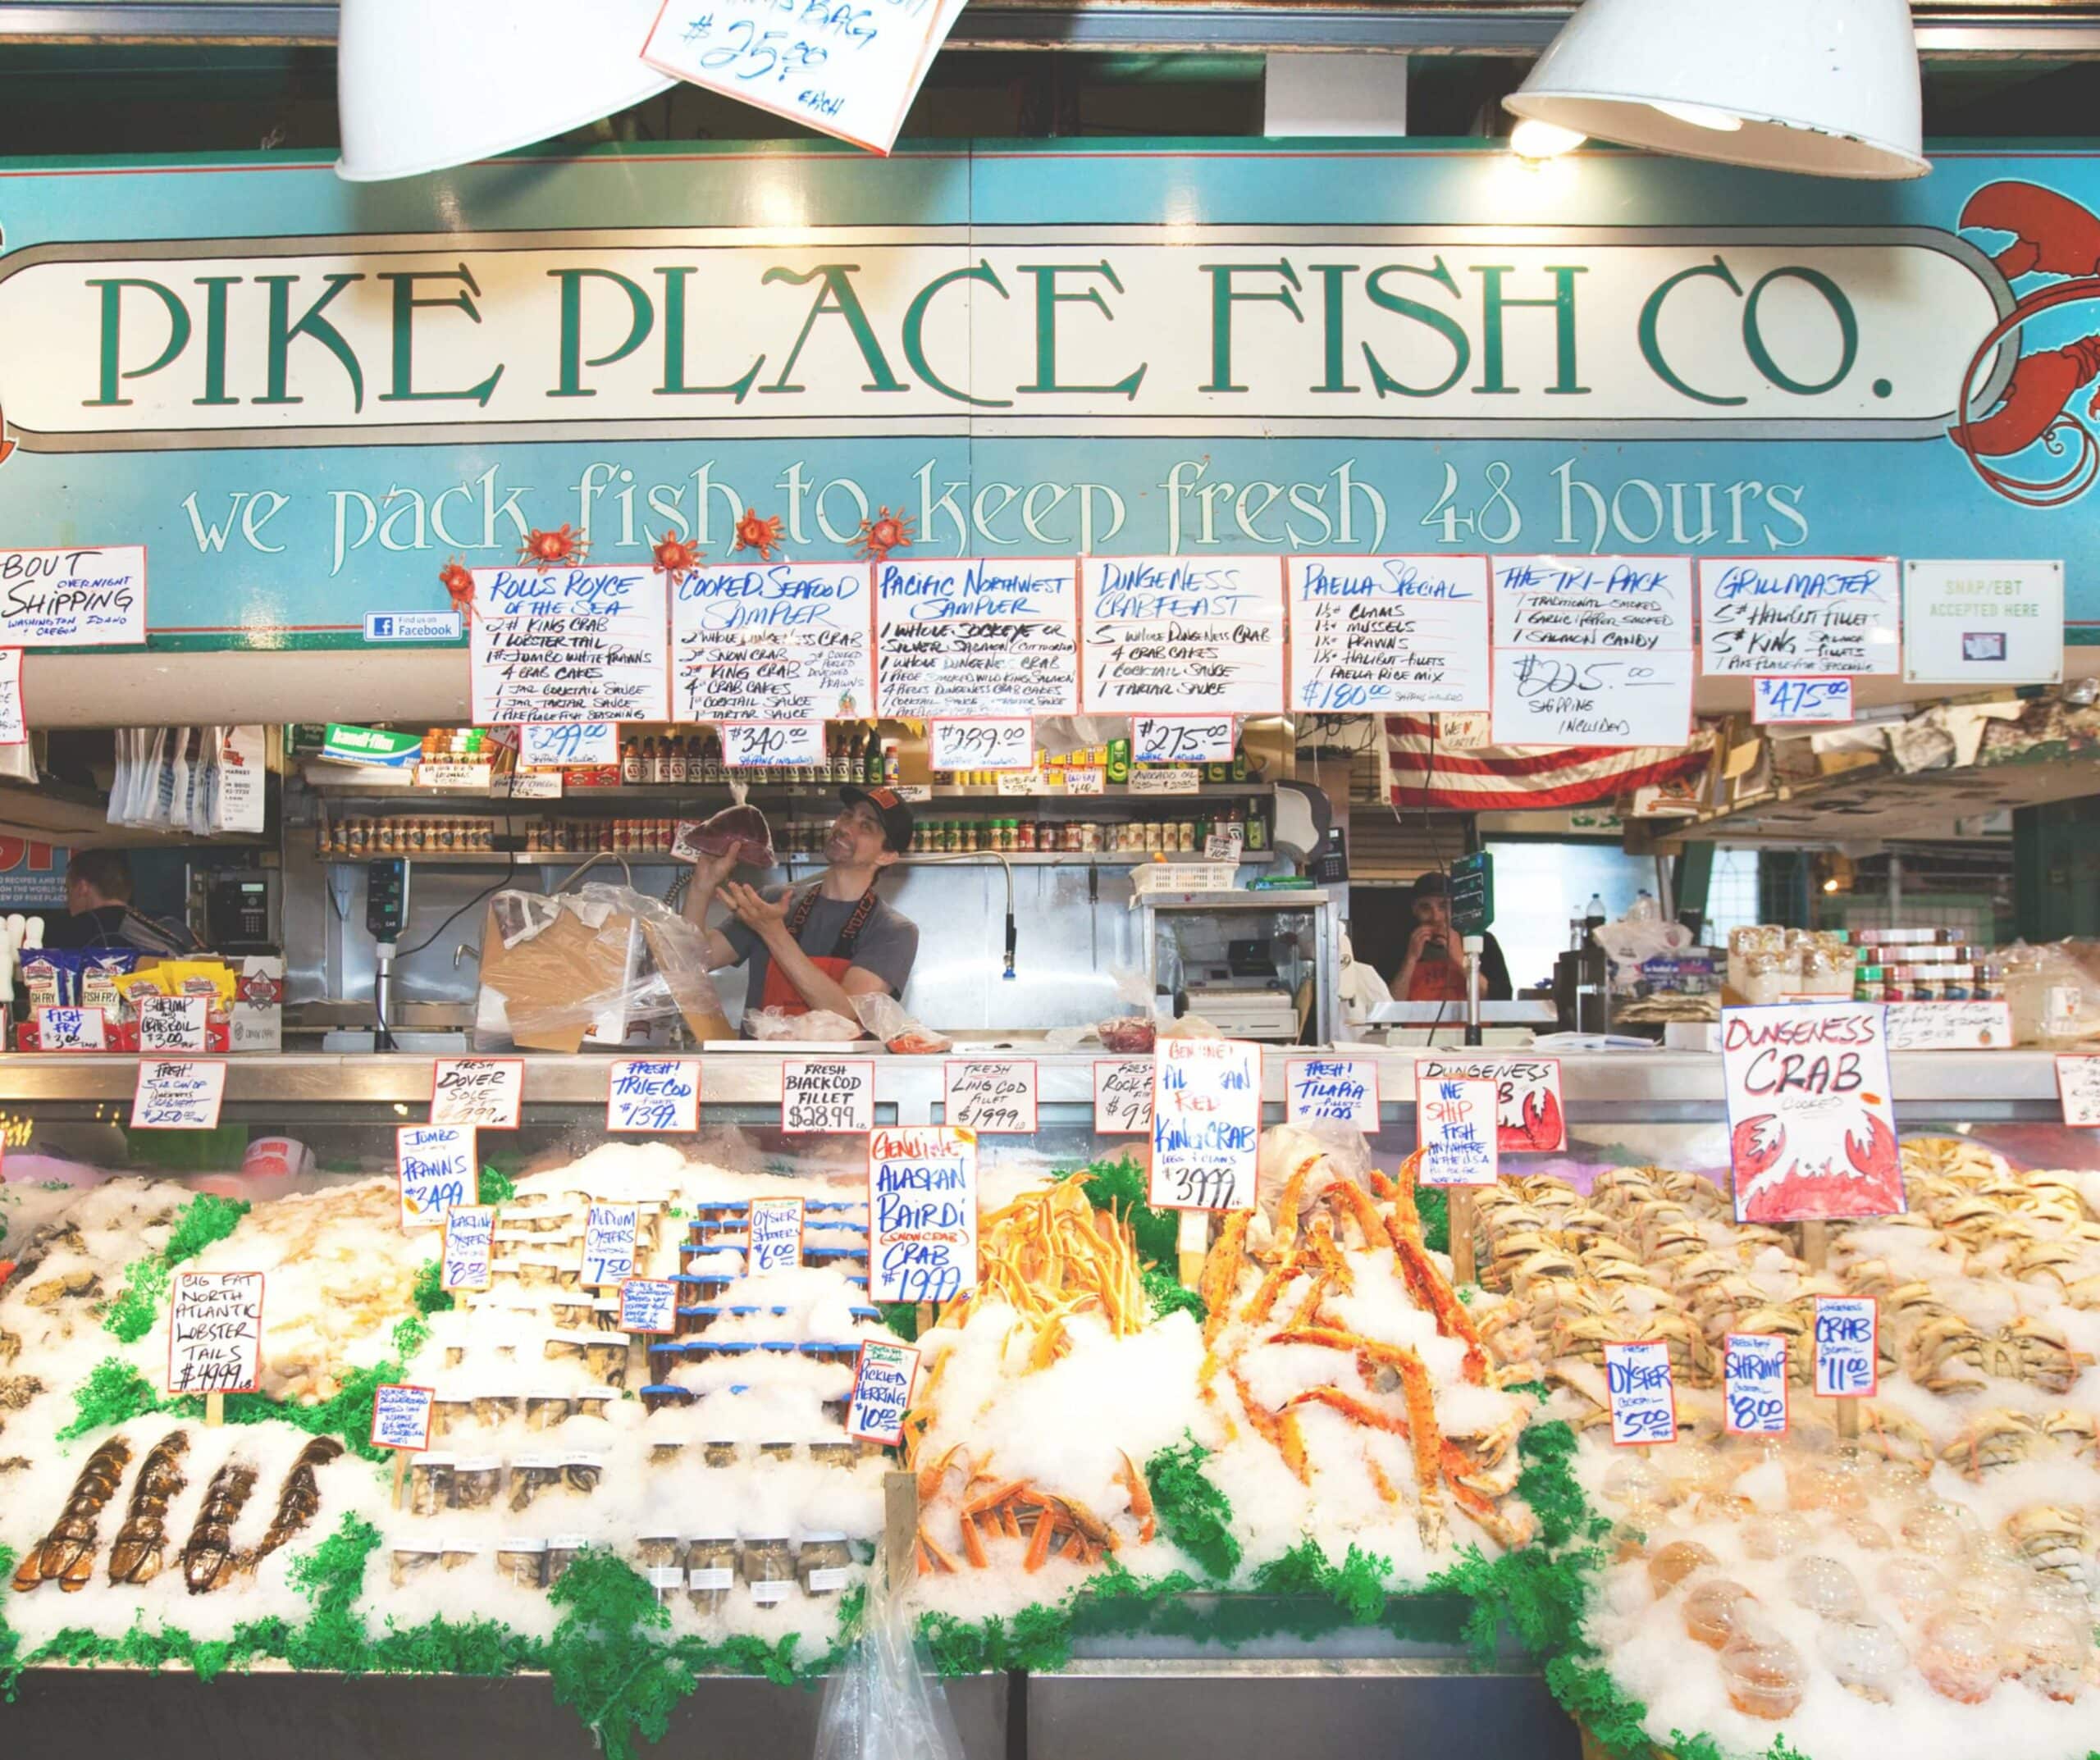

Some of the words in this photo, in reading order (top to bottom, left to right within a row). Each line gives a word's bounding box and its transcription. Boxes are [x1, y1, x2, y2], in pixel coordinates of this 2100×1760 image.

[797, 89, 847, 117] EACH
[81, 261, 505, 415] PIKE
[545, 258, 1148, 409] PLACE
[1198, 256, 1593, 400] FISH
[1637, 255, 1893, 407] CO.
[180, 487, 292, 554] we
[326, 461, 532, 577] pack
[578, 459, 745, 556] fish
[774, 461, 873, 549] to
[909, 458, 1128, 556] keep
[1157, 456, 1388, 558] fresh
[1421, 461, 1524, 549] 48
[1549, 456, 1810, 553] hours
[0, 551, 103, 579] BOUT
[57, 577, 132, 589] OVERNIGHT
[679, 570, 763, 600] COOKED
[759, 566, 860, 600] SEAFOOD
[964, 559, 1074, 597] NORTHWEST
[1100, 561, 1239, 595] DUNGENESS
[1303, 563, 1377, 600] PAELLA
[1496, 564, 1546, 589] THE
[491, 571, 556, 601] ROLLS
[564, 570, 644, 602] ROYCE
[1714, 567, 1887, 603] GRILLMASTER
[527, 601, 562, 614] THE
[571, 600, 632, 616] SEA
[910, 596, 1040, 621] SAMPLER
[1528, 596, 1607, 609] TRADITIONAL
[1929, 604, 1997, 617] ACCEPTED
[2005, 604, 2039, 617] HERE
[701, 600, 839, 630] SAMPLER
[1349, 604, 1405, 620] CLAMS
[36, 627, 77, 636] OREGON
[399, 625, 452, 635] Facebook
[527, 618, 564, 632] KING
[569, 618, 609, 632] CRAB
[894, 622, 952, 638] WHOLE
[1346, 621, 1416, 633] MUSSELS
[506, 634, 569, 647] LOBSTER
[818, 630, 863, 648] CRAB
[1232, 624, 1271, 643] CRAB
[1526, 629, 1597, 645] SALMON
[1603, 632, 1659, 650] CANDY
[1347, 635, 1408, 650] PRAWNS
[706, 649, 750, 661] SNOW
[749, 648, 789, 661] CRAB
[1129, 647, 1166, 660] CRAB
[1169, 647, 1218, 659] CAKES
[1341, 650, 1399, 666] HALIBUT
[710, 664, 750, 679] KING
[756, 661, 801, 679] CRAB
[892, 657, 938, 669] WHOLE
[1113, 663, 1180, 677] COCKTAIL
[1184, 663, 1240, 677] SAUCE
[518, 666, 550, 678] CRAB
[555, 666, 603, 679] CAKES
[1331, 665, 1372, 679] PAELLA
[604, 682, 651, 695] SAUCE
[707, 677, 743, 695] CRAB
[746, 682, 792, 695] CAKES
[1114, 683, 1172, 695] TARTAR
[593, 698, 639, 707] SAUCE
[763, 695, 818, 707] SAUCE
[587, 709, 645, 719] SEASONING
[707, 709, 760, 719] TARTAR
[764, 708, 815, 719] SAUCE
[1134, 771, 1176, 779] AVOCADO
[46, 1009, 84, 1022] FISH
[53, 1023, 82, 1033] FRY
[1724, 1015, 1876, 1051] DUNGENESS
[805, 1065, 847, 1074] FRESH
[965, 1065, 1013, 1075] FRESH
[1427, 1063, 1551, 1082] DUNGENESS
[1745, 1048, 1863, 1096] CRAB
[437, 1071, 505, 1088] DOVER
[661, 1078, 692, 1097] COD
[446, 1088, 498, 1101] SOLE
[995, 1082, 1027, 1094] COD
[1440, 1082, 1467, 1101] WE
[799, 1092, 854, 1105] FILLET
[404, 1130, 459, 1146] JUMBO
[1203, 1120, 1255, 1153] CRAB
[1441, 1123, 1477, 1140] FISH
[402, 1156, 467, 1182] PRAWNS
[876, 1157, 966, 1192] ALASKAN
[883, 1242, 950, 1271] CRAB
[222, 1274, 256, 1286] FAT
[182, 1289, 242, 1302] NORTH
[176, 1322, 256, 1343] LOBSTER
[1816, 1315, 1872, 1343] CRAB
[182, 1344, 241, 1362] TAILS
[1725, 1352, 1787, 1379] SHRIMP
[1608, 1357, 1673, 1394] OYSTER
[855, 1381, 906, 1407] HERRING
